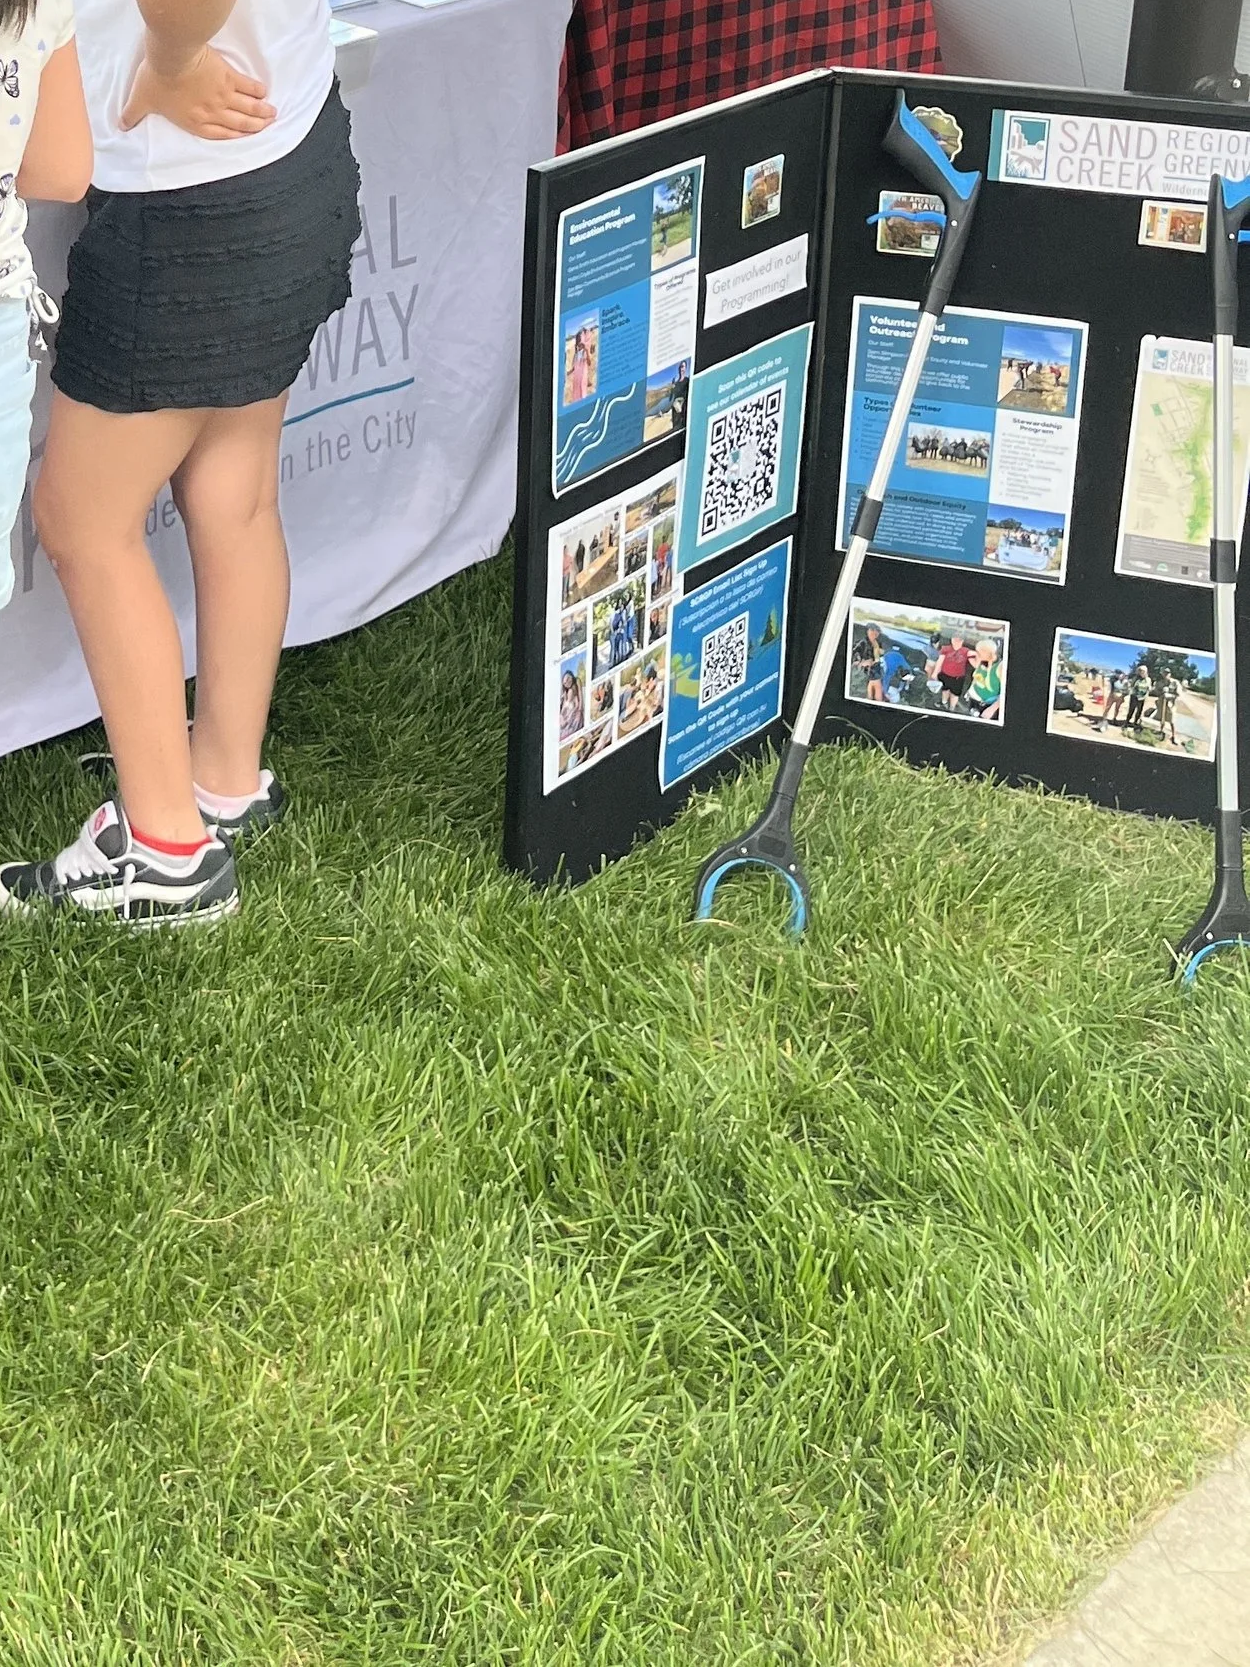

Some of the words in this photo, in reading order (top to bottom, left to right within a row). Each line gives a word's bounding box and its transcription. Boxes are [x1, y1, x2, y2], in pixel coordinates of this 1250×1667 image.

[1059, 120, 1157, 160] SAND
[1056, 156, 1154, 191] CREEK
[570, 206, 621, 234] Environmental
[570, 222, 605, 245] Education
[605, 214, 636, 231] Program
[712, 279, 733, 294] Get
[733, 259, 772, 287] involved
[774, 257, 783, 269] in
[785, 250, 802, 265] our
[721, 274, 789, 312] Programming!
[869, 315, 918, 330] Voluntee
[933, 323, 946, 332] nd
[929, 335, 969, 345] ogram
[1170, 362, 1205, 375] CREEK
[1171, 350, 1206, 365] SAND
[707, 402, 718, 413] see
[719, 395, 730, 406] our
[730, 380, 758, 401] calendar
[759, 375, 767, 386] of
[767, 366, 789, 382] events
[718, 380, 734, 393] Scan
[735, 372, 747, 383] this
[747, 367, 757, 378] QR
[758, 360, 774, 373] code
[774, 356, 782, 365] to
[863, 396, 889, 407] Types
[911, 402, 942, 413] lunteer
[1013, 417, 1062, 430] Stewardship
[1019, 425, 1055, 435] Program
[306, 430, 351, 473] the
[362, 409, 417, 455] City
[713, 578, 730, 594] Email
[731, 572, 743, 584] List
[743, 564, 758, 578] Sign
[758, 559, 768, 569] Up
[668, 730, 685, 744] Scan
[685, 722, 696, 734] the
[697, 715, 707, 727] QR
[707, 704, 725, 720] Code
[725, 695, 739, 708] with
[738, 686, 754, 701] your
[754, 671, 778, 691] camera
